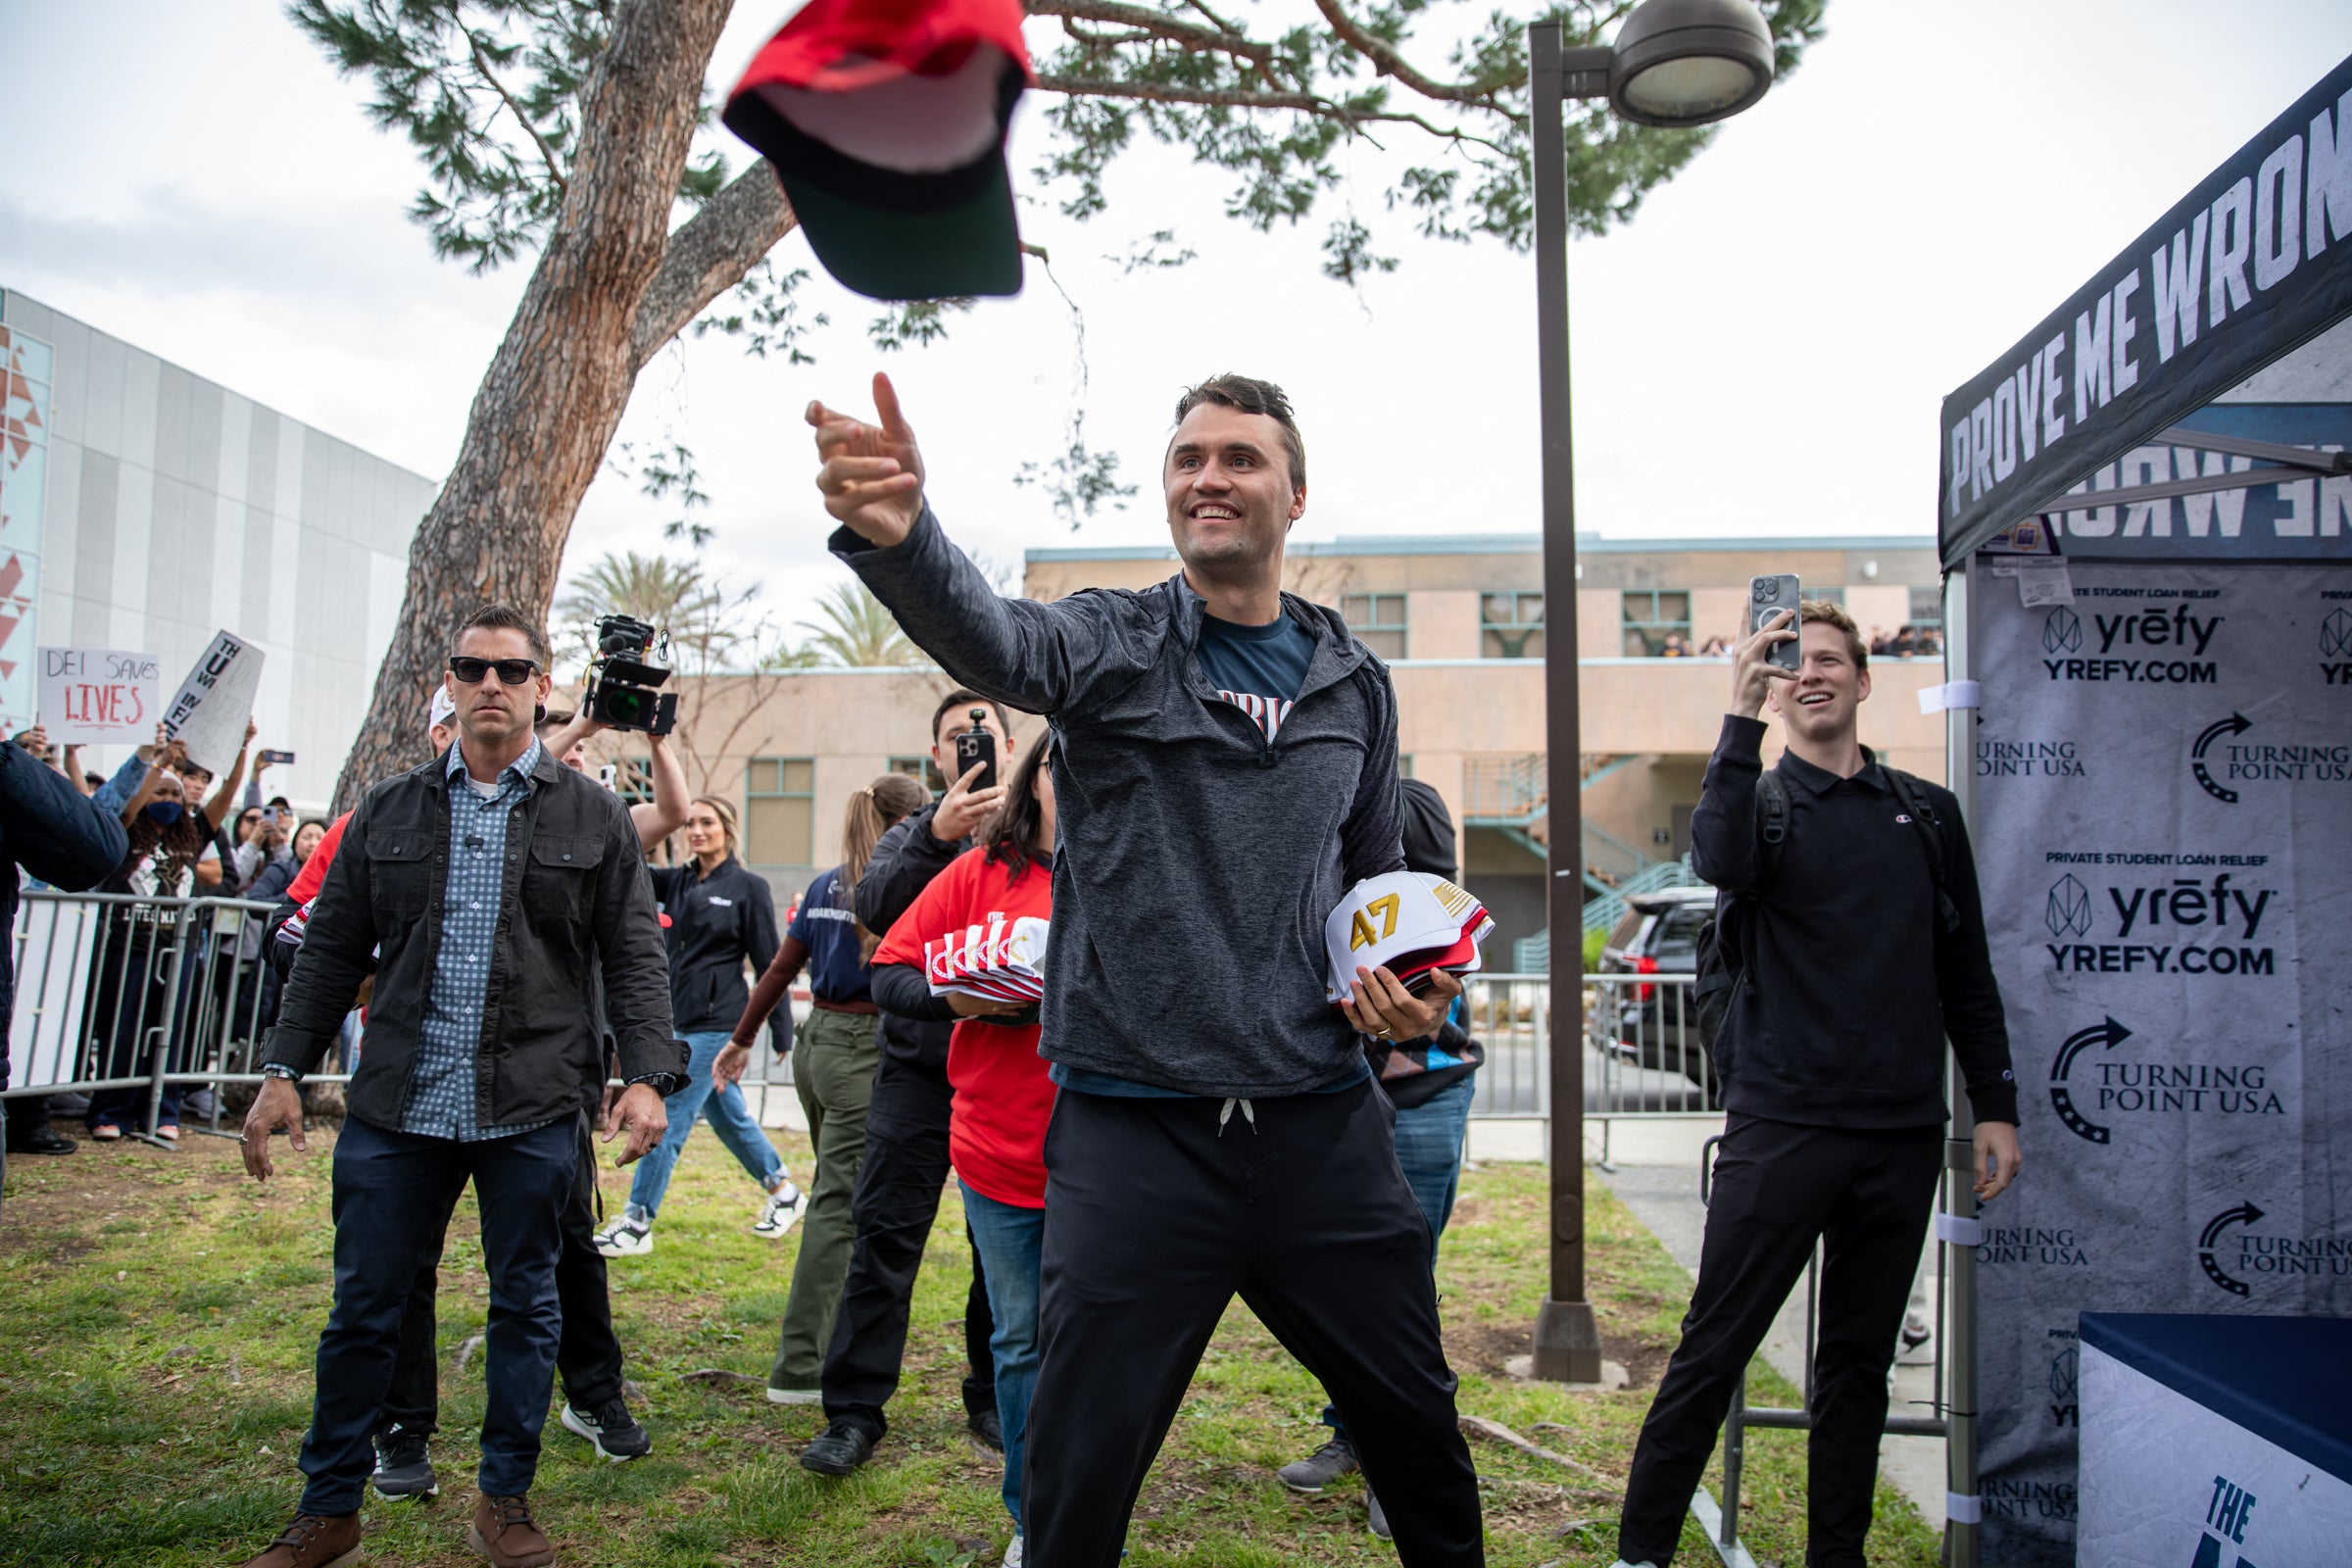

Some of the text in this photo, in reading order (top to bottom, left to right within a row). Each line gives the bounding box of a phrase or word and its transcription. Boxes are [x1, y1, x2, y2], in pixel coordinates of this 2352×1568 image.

[1949, 331, 2065, 517] PROVE
[2075, 268, 2139, 425] ME
[2093, 588, 2144, 599] STUDENT
[2147, 589, 2179, 599] LOAN
[2181, 590, 2221, 599] RELIEF
[47, 650, 159, 681] DEI SAVES
[2043, 660, 2217, 683] YREFY.COM
[65, 683, 144, 725] LIVES
[1977, 742, 2076, 760] URNING
[2227, 746, 2350, 763] TURNING
[1976, 759, 2085, 776] OINT USA
[2229, 763, 2309, 780] POINT
[2046, 853, 2269, 866] PRIVATE STUDENT LOAN RELIEF
[1349, 892, 1400, 953] 47
[2046, 944, 2275, 975] YREFY.COM
[2095, 1063, 2266, 1089] TURNING
[2098, 1088, 2287, 1114] POINT USA
[1981, 1228, 2075, 1248] URNING
[1976, 1245, 2088, 1265] OINT USA
[2239, 1253, 2324, 1274] POINT
[2206, 1474, 2257, 1544] THE
